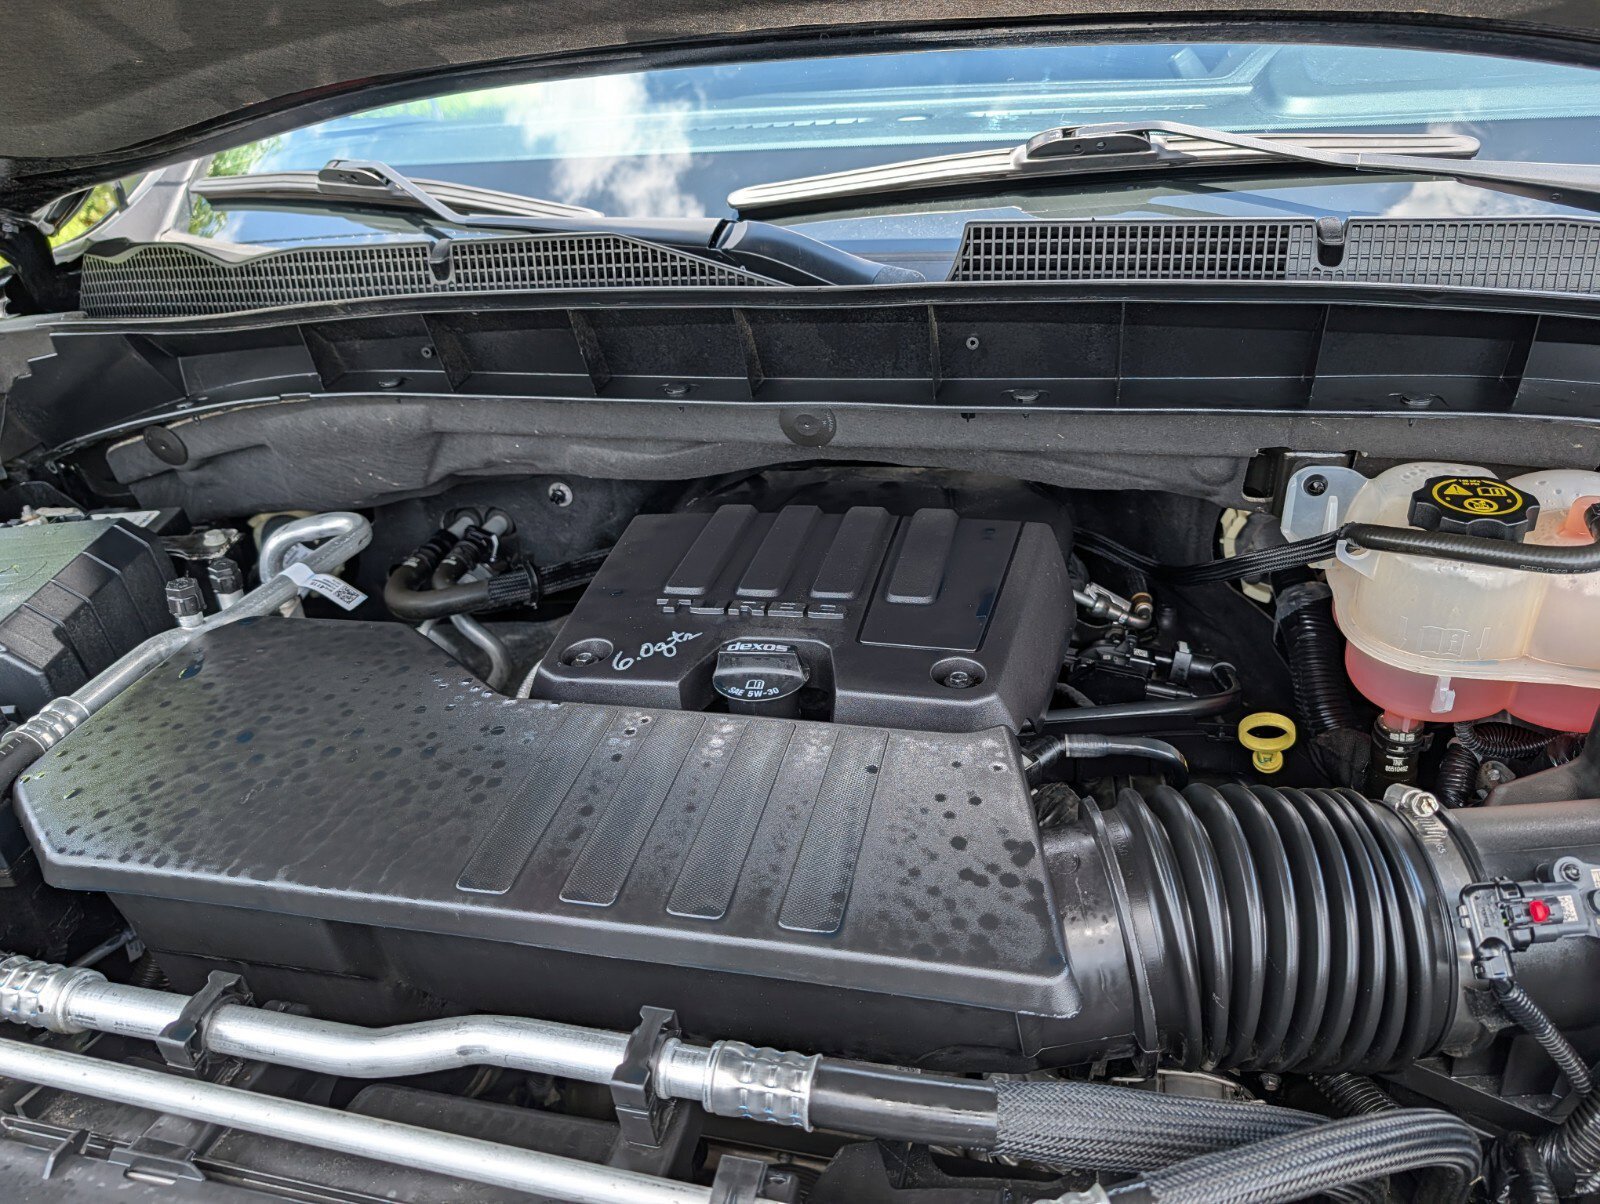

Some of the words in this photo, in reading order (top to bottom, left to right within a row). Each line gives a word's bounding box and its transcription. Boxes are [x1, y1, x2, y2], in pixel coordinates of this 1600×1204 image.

[656, 598, 845, 619] TURBO
[727, 642, 790, 652] dexos
[728, 687, 745, 696] SAE
[747, 687, 780, 698] 5W-30
